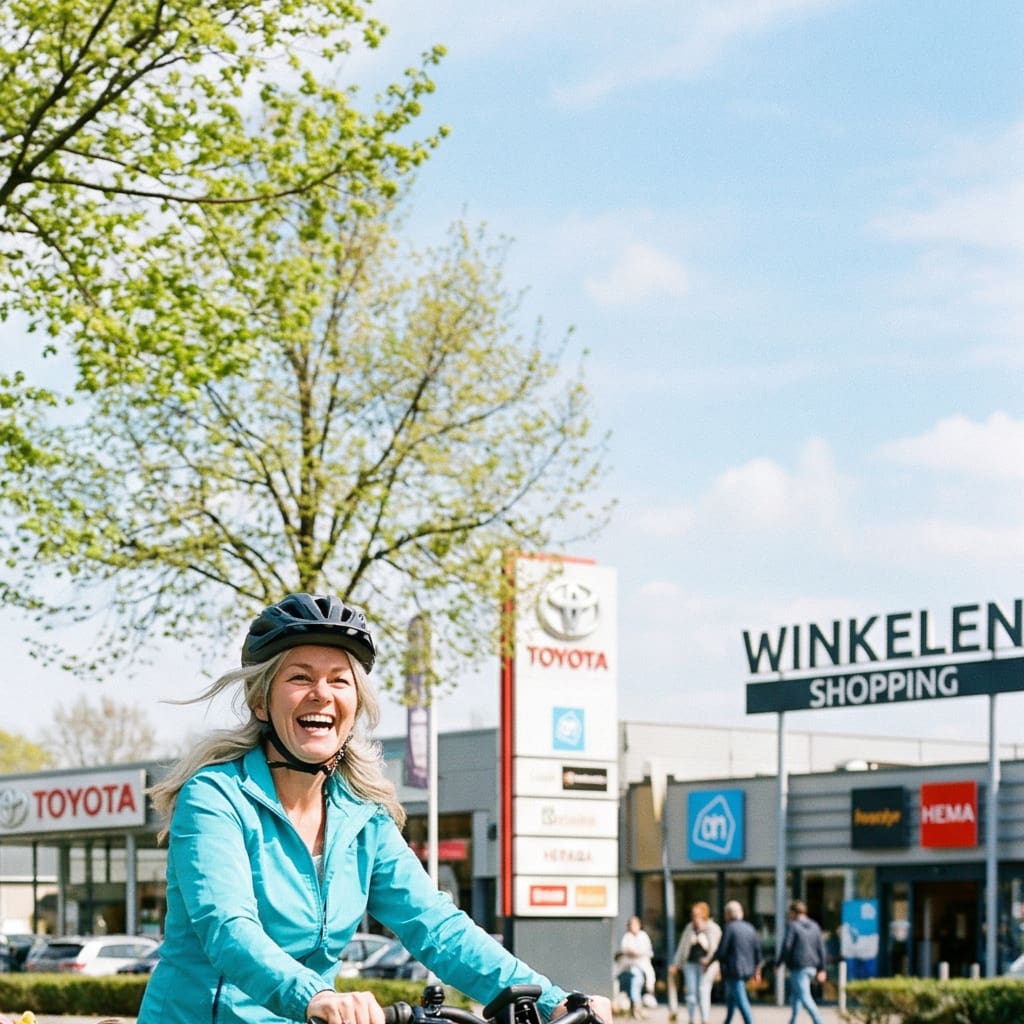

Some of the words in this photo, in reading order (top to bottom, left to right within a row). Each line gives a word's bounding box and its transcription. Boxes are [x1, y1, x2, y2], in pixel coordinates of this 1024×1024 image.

[742, 598, 1023, 674] WINKELEN
[527, 645, 608, 671] TOYOTA
[809, 665, 959, 708] SHOPPING
[33, 783, 137, 819] TOYOTA
[921, 803, 975, 824] HEMA
